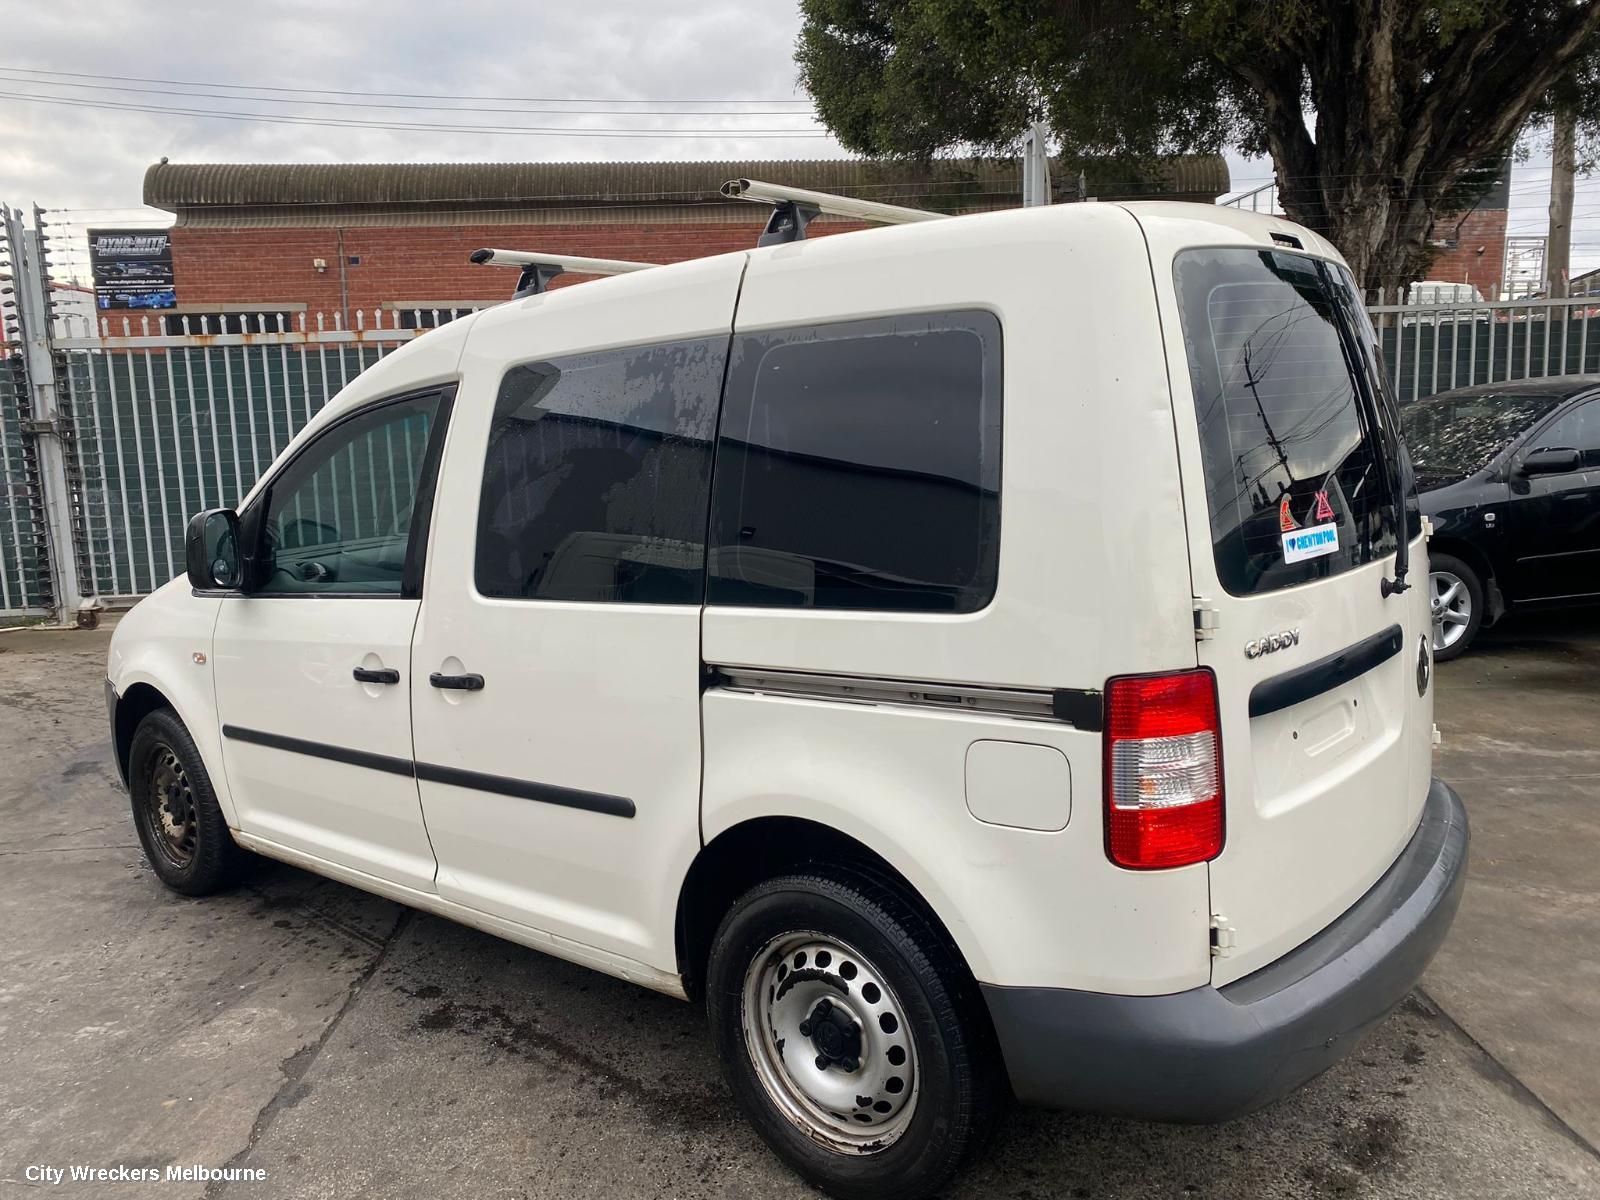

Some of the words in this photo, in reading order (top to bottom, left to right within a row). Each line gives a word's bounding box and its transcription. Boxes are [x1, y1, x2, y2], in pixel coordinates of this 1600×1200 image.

[98, 237, 166, 248] DYNO-MITE
[1323, 529, 1336, 545] POOL
[1244, 627, 1300, 660] CADDY
